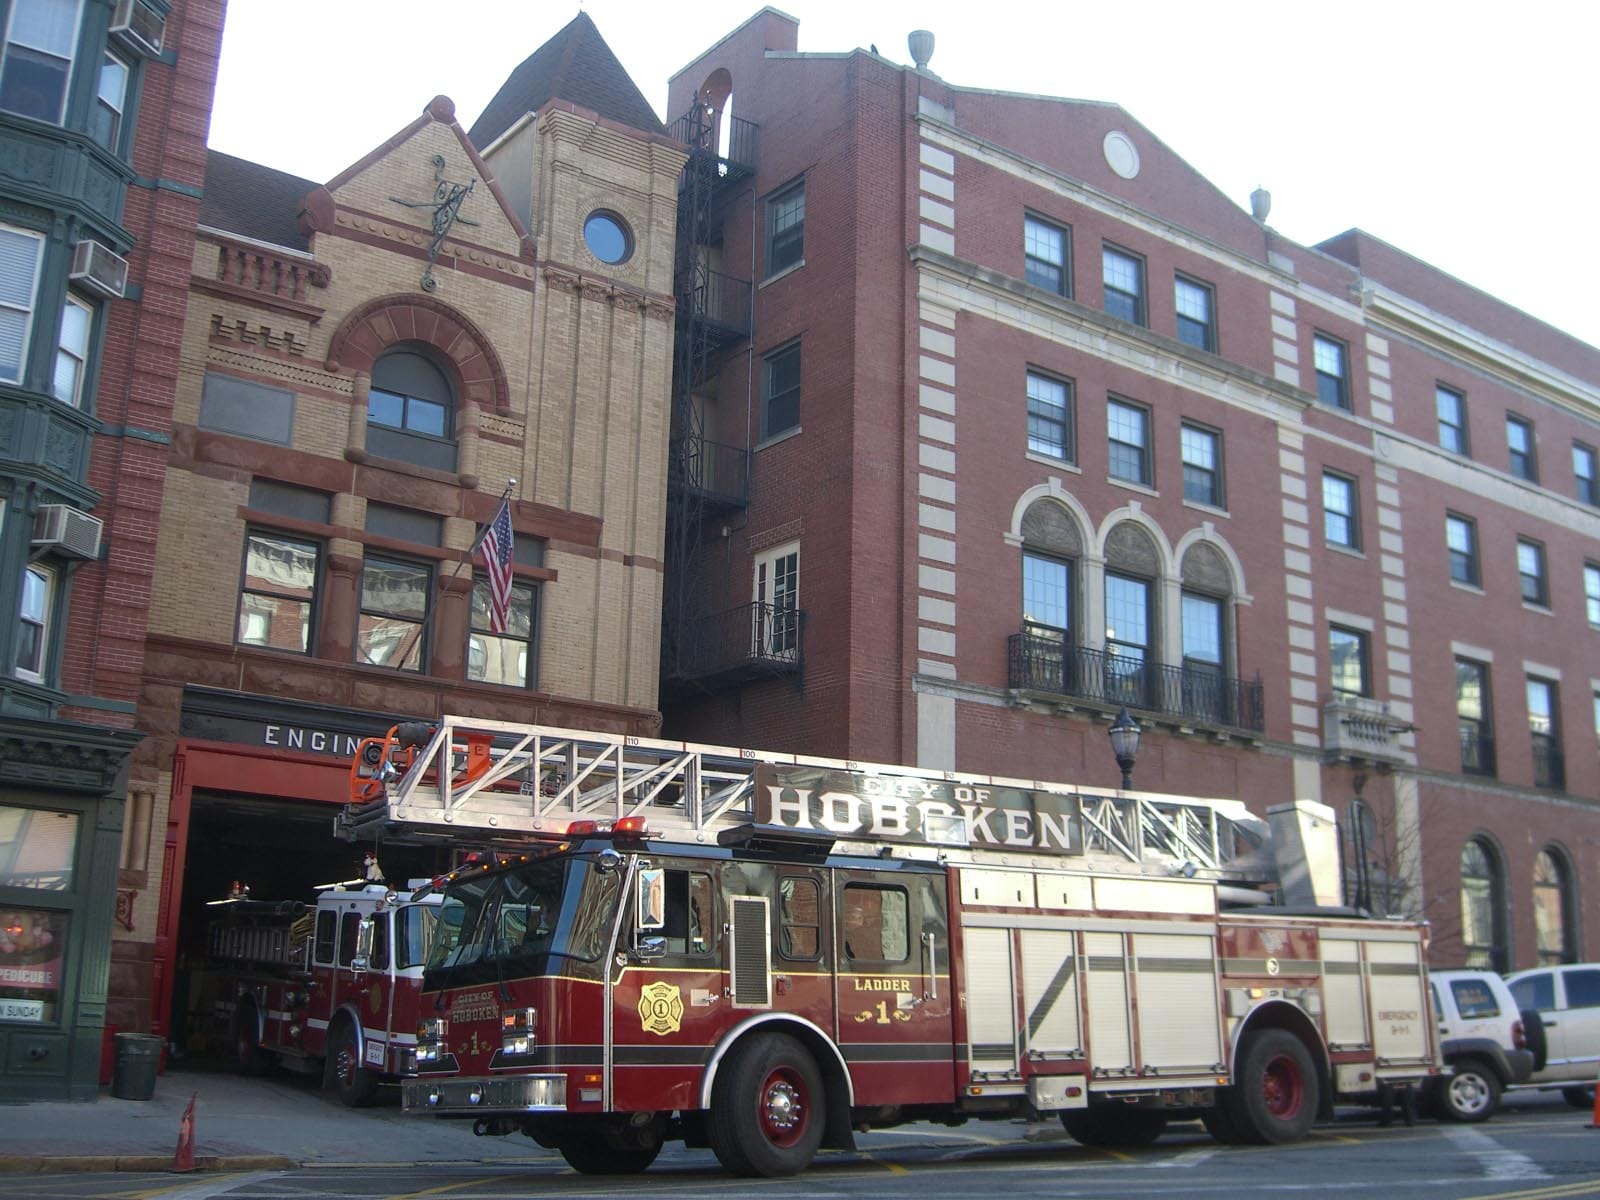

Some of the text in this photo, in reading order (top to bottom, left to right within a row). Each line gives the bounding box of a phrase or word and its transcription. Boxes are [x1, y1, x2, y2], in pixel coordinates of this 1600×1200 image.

[265, 725, 377, 759] ENGIN
[627, 737, 639, 746] 110
[743, 750, 756, 758] 100
[863, 777, 992, 804] CITY OF
[855, 978, 911, 992] LADDER
[481, 991, 494, 1000] OF
[7, 1005, 41, 1017] SUNDAY
[453, 1005, 499, 1023] HOBOKEN
[657, 1002, 664, 1015] 1
[876, 1000, 891, 1024] 1
[471, 1031, 480, 1056] 1
